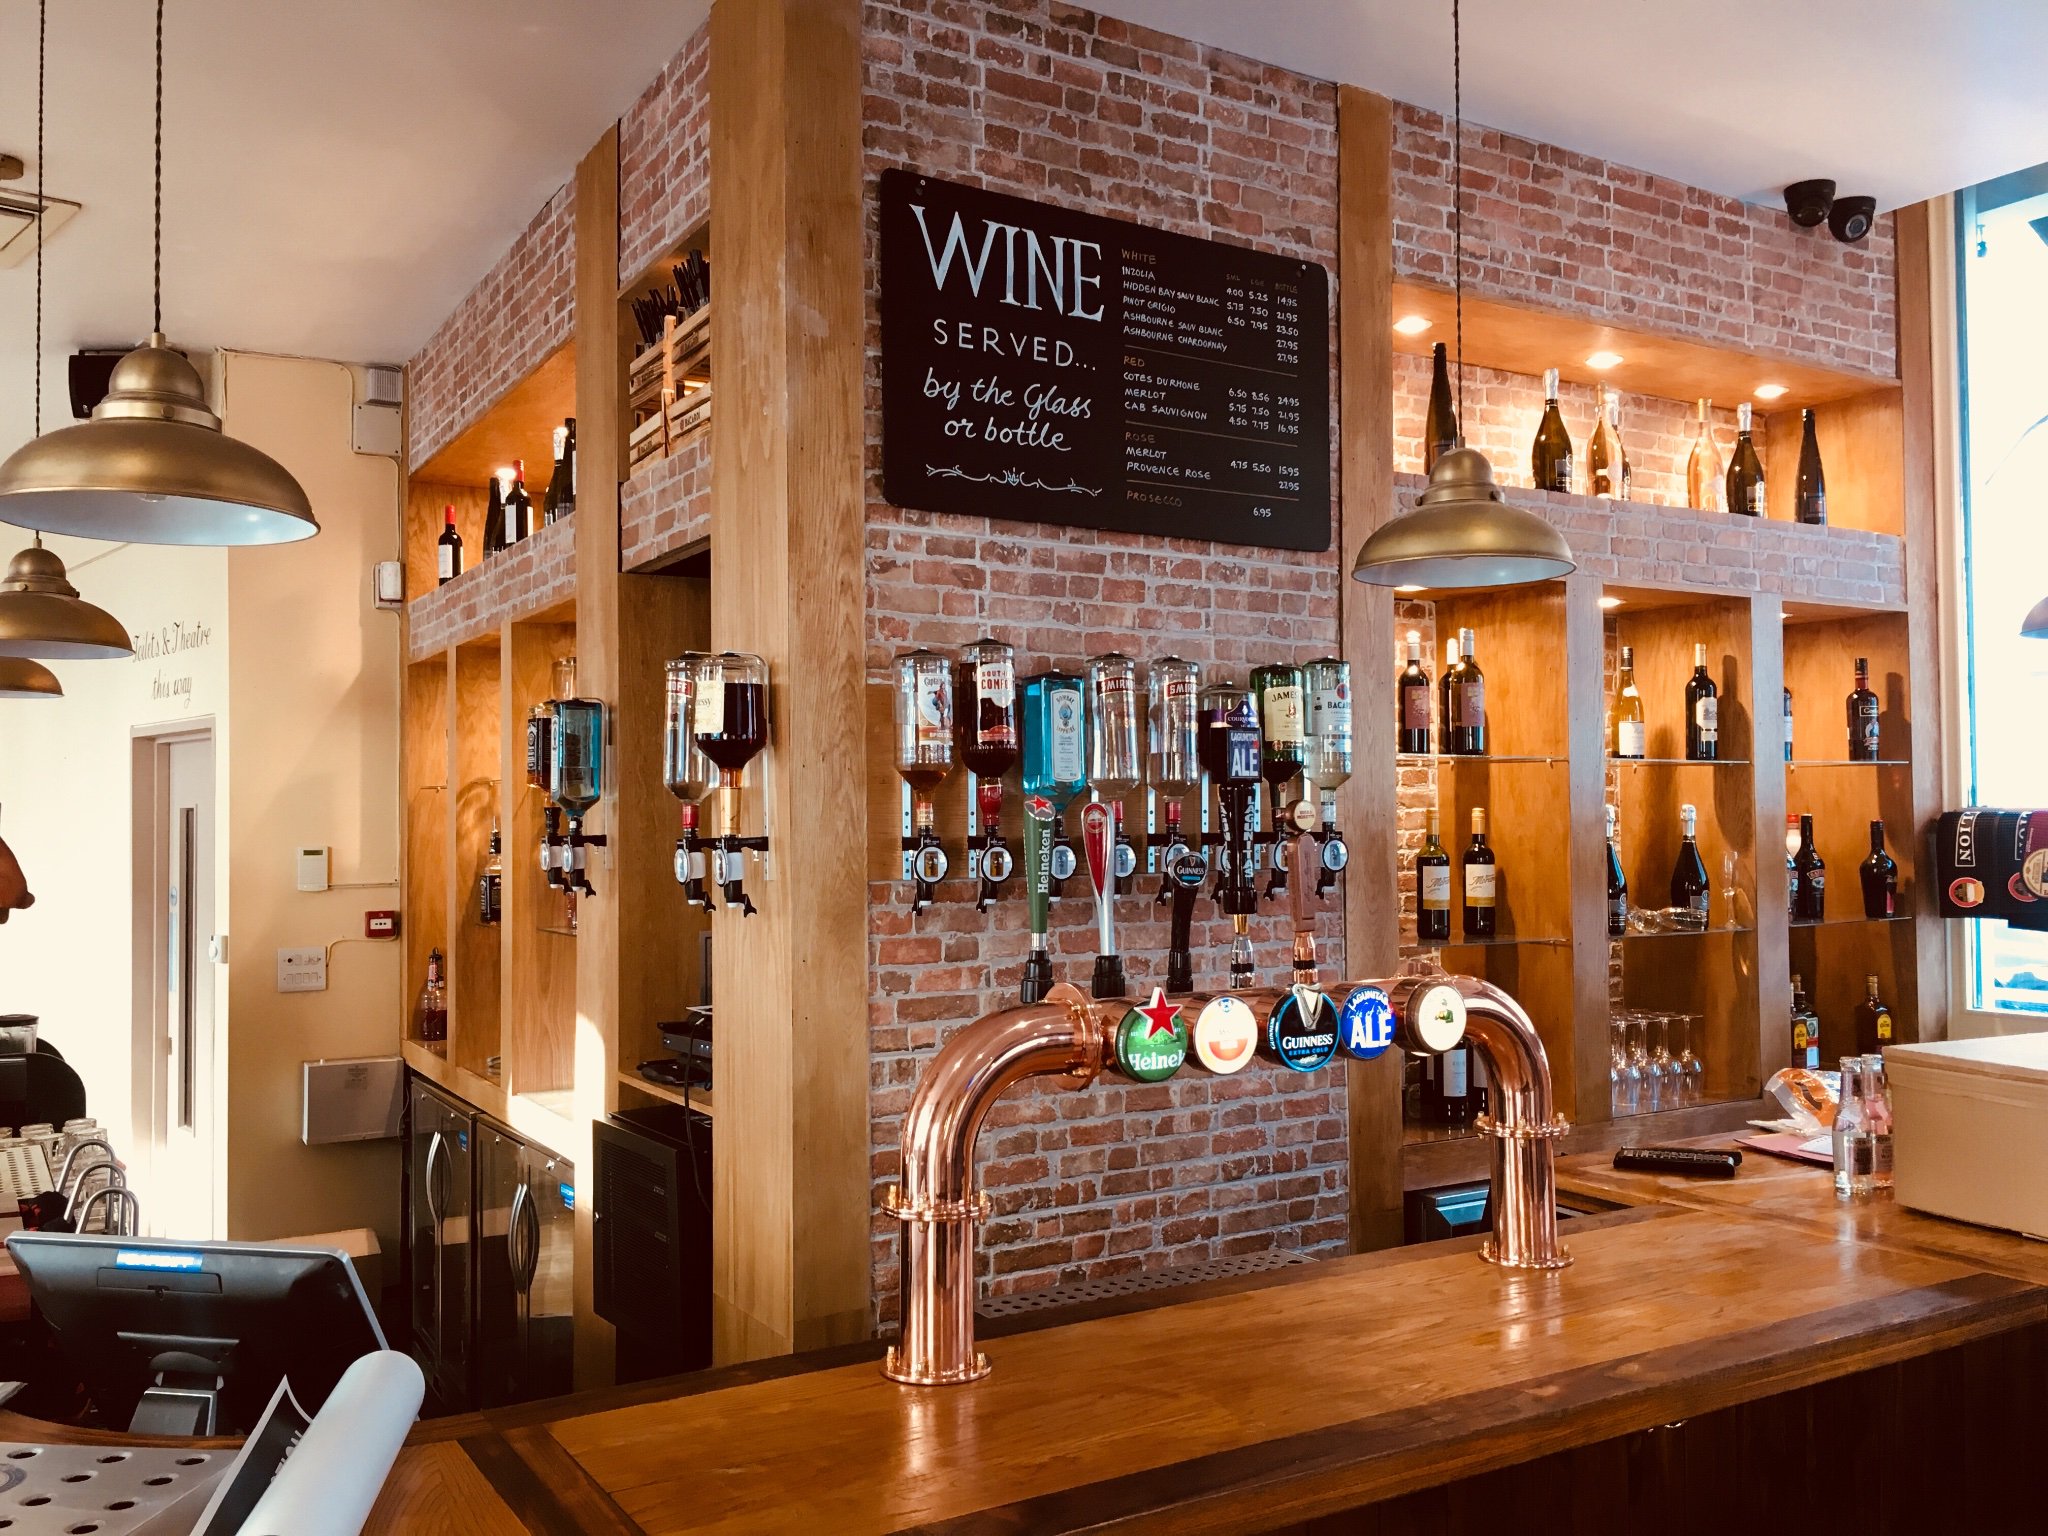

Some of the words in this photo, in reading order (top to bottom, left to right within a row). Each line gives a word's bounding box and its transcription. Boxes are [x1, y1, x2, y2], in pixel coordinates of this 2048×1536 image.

[908, 203, 1105, 322] WINE
[1121, 248, 1157, 265] WHITE
[1121, 266, 1156, 281] INZOLIA
[1122, 281, 1157, 295] HIDDEN
[1157, 287, 1176, 300] BAY
[1176, 292, 1195, 301] SAUV
[1196, 295, 1220, 307] BLANC
[1248, 291, 1269, 302] 5.25
[1276, 296, 1298, 307] 14.95
[1122, 295, 1146, 307] PINOT
[1147, 300, 1176, 314] GRIGIO
[1226, 301, 1244, 311] 5.75
[1276, 311, 1298, 322] 21.95
[1122, 310, 1175, 328] ASHBOURNE
[1177, 321, 1196, 332] SAUV
[1198, 325, 1224, 337] BLANC
[1227, 315, 1245, 327] 6.50
[1250, 320, 1268, 330] 7.95
[1276, 325, 1299, 337] 23.50
[1122, 325, 1174, 341] ASHBOURNE
[1177, 335, 1228, 352] CHARDONNAY
[1275, 339, 1298, 350] 27.95
[1123, 355, 1146, 367] RED
[1276, 352, 1299, 364] 27.95
[1123, 371, 1153, 384] COTES
[1156, 376, 1169, 386] DU
[923, 366, 961, 411] by
[970, 375, 1016, 407] the
[1023, 383, 1092, 421] Glass
[1124, 388, 1167, 401] MERLOT
[1228, 388, 1248, 399] 6.50
[1277, 396, 1300, 407] 24.95
[1124, 401, 1146, 412] CAB
[1151, 405, 1208, 420] SAUVIGNON
[1228, 402, 1247, 413] 5.75
[1277, 410, 1300, 421] 21.95
[944, 417, 977, 439] or
[984, 416, 1072, 452] bottle
[1125, 431, 1156, 444] ROSE
[1277, 423, 1299, 434] 16.95
[1126, 446, 1167, 459] MERLOT
[1126, 461, 1180, 477] PROVENCE
[1184, 468, 1212, 481] ROSE
[1278, 465, 1300, 476] 15.95
[1126, 490, 1183, 508] PROSECCO
[1252, 507, 1272, 517] 6.95
[162, 626, 170, 656] &
[152, 668, 170, 701] this
[173, 676, 193, 710] way
[1231, 748, 1259, 777] ALE
[1242, 795, 1255, 878] LAGUNITAS
[1037, 828, 1051, 894] Heineken
[1176, 865, 1205, 875] GUINNESS
[1350, 1011, 1392, 1049] ALE
[1282, 1033, 1334, 1050] GUINNESS
[1311, 1046, 1329, 1054] COLD
